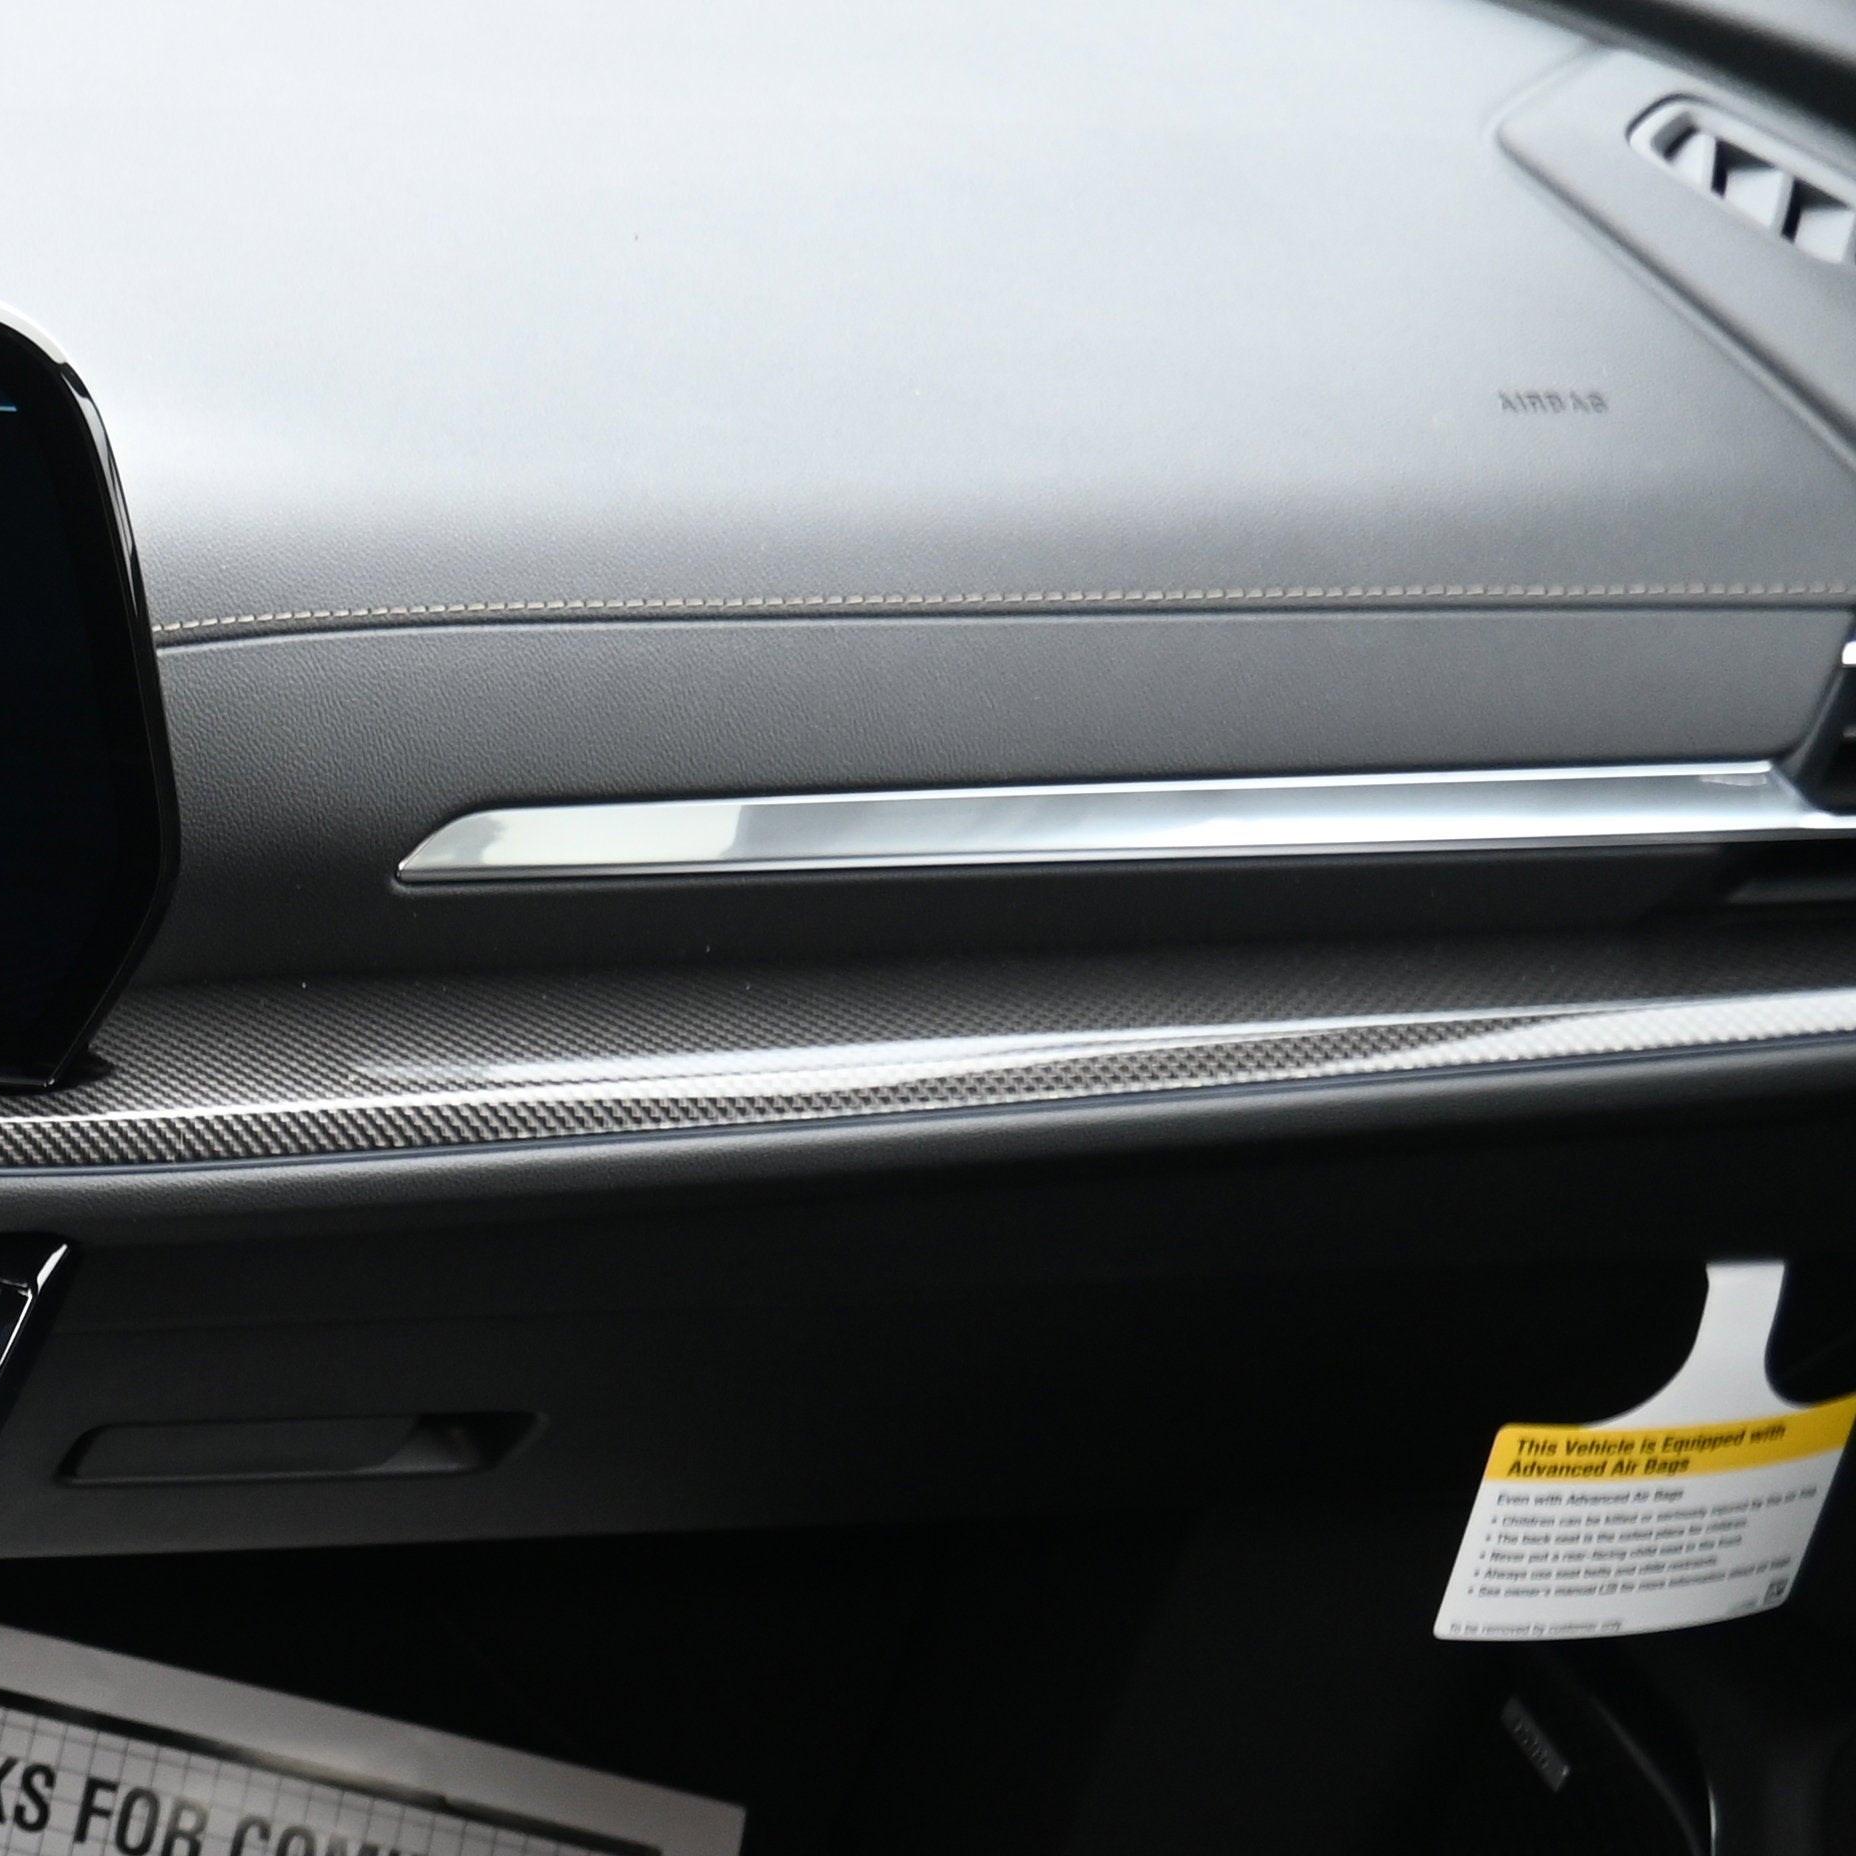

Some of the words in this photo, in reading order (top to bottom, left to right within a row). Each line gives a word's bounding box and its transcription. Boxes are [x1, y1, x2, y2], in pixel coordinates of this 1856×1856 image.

[1498, 390, 1608, 414] AIRBAG
[1517, 1439, 1556, 1457] This
[1565, 1437, 1636, 1457] Vehicle
[1641, 1437, 1657, 1454] is
[1661, 1432, 1745, 1455] Equipped
[1751, 1424, 1786, 1444] with
[1507, 1459, 1605, 1479] Advanced
[1610, 1458, 1637, 1477] Air
[1644, 1456, 1690, 1477] Bags
